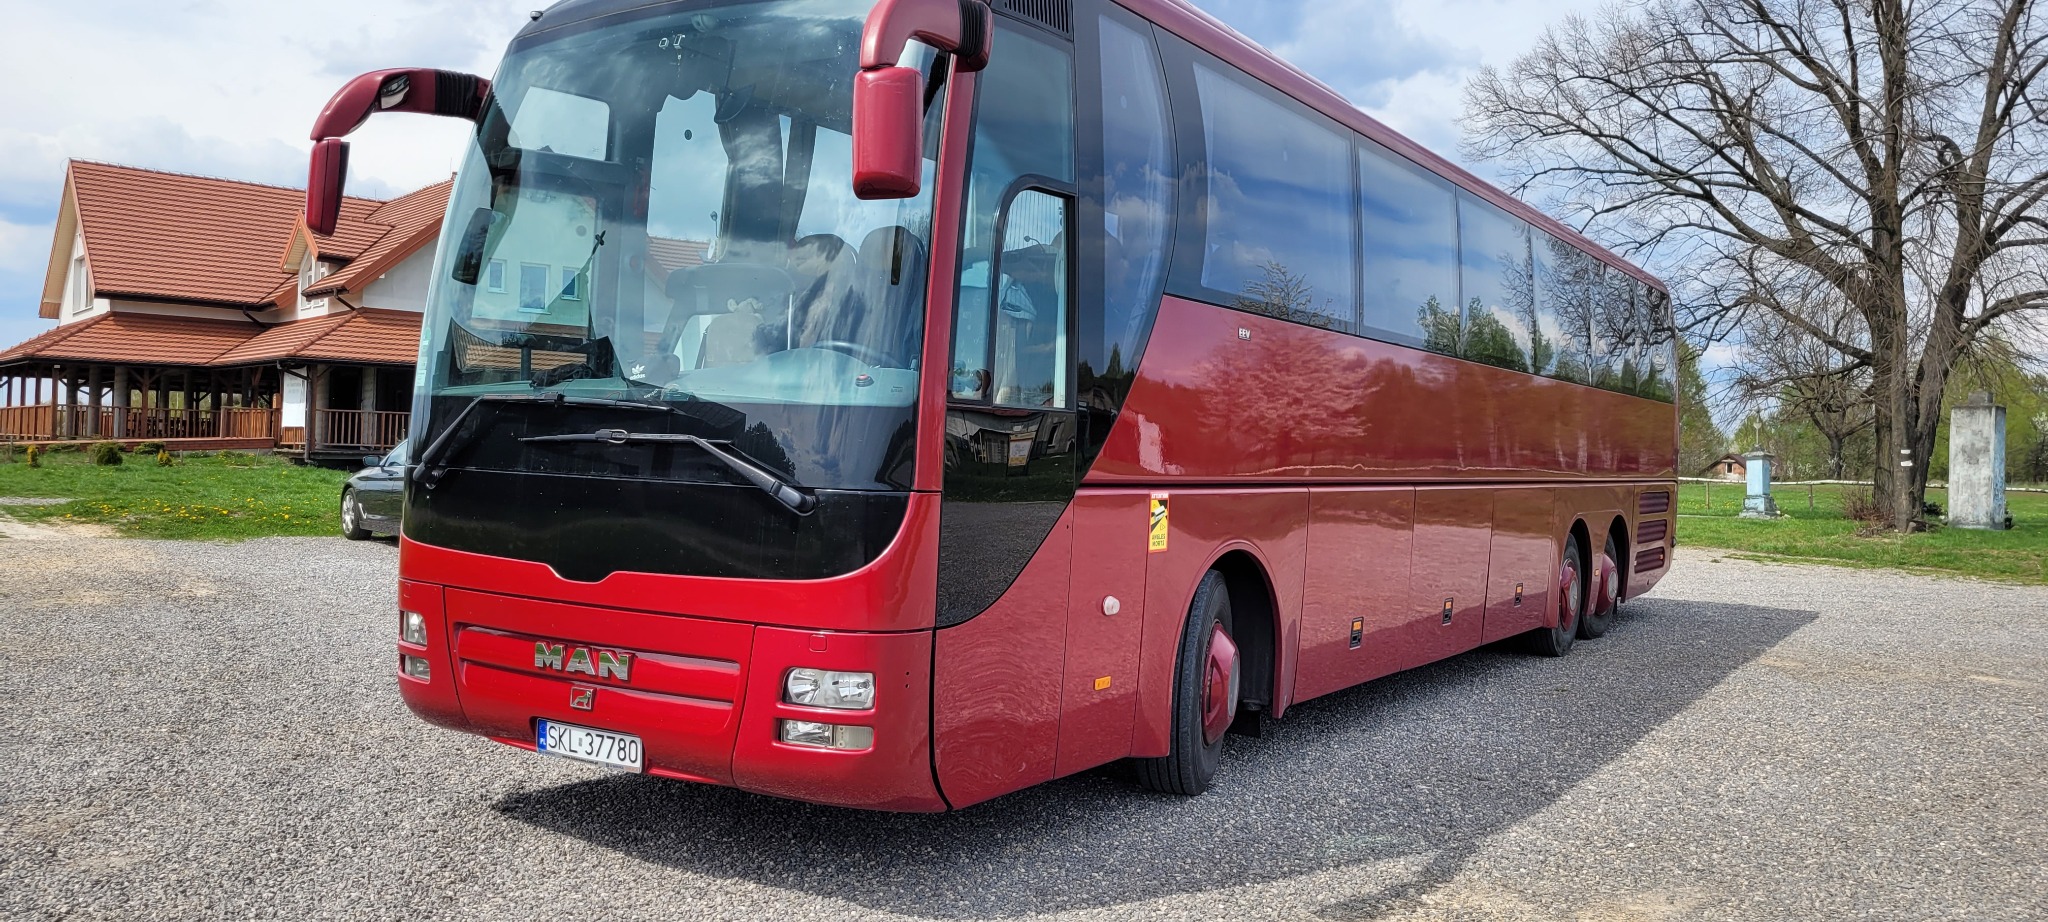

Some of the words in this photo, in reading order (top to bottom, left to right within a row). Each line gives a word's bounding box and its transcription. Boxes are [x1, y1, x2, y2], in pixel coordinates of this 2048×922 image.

[535, 641, 630, 680] MAN
[540, 738, 547, 746] PL
[548, 725, 578, 754] SKL
[585, 732, 638, 764] 37780
